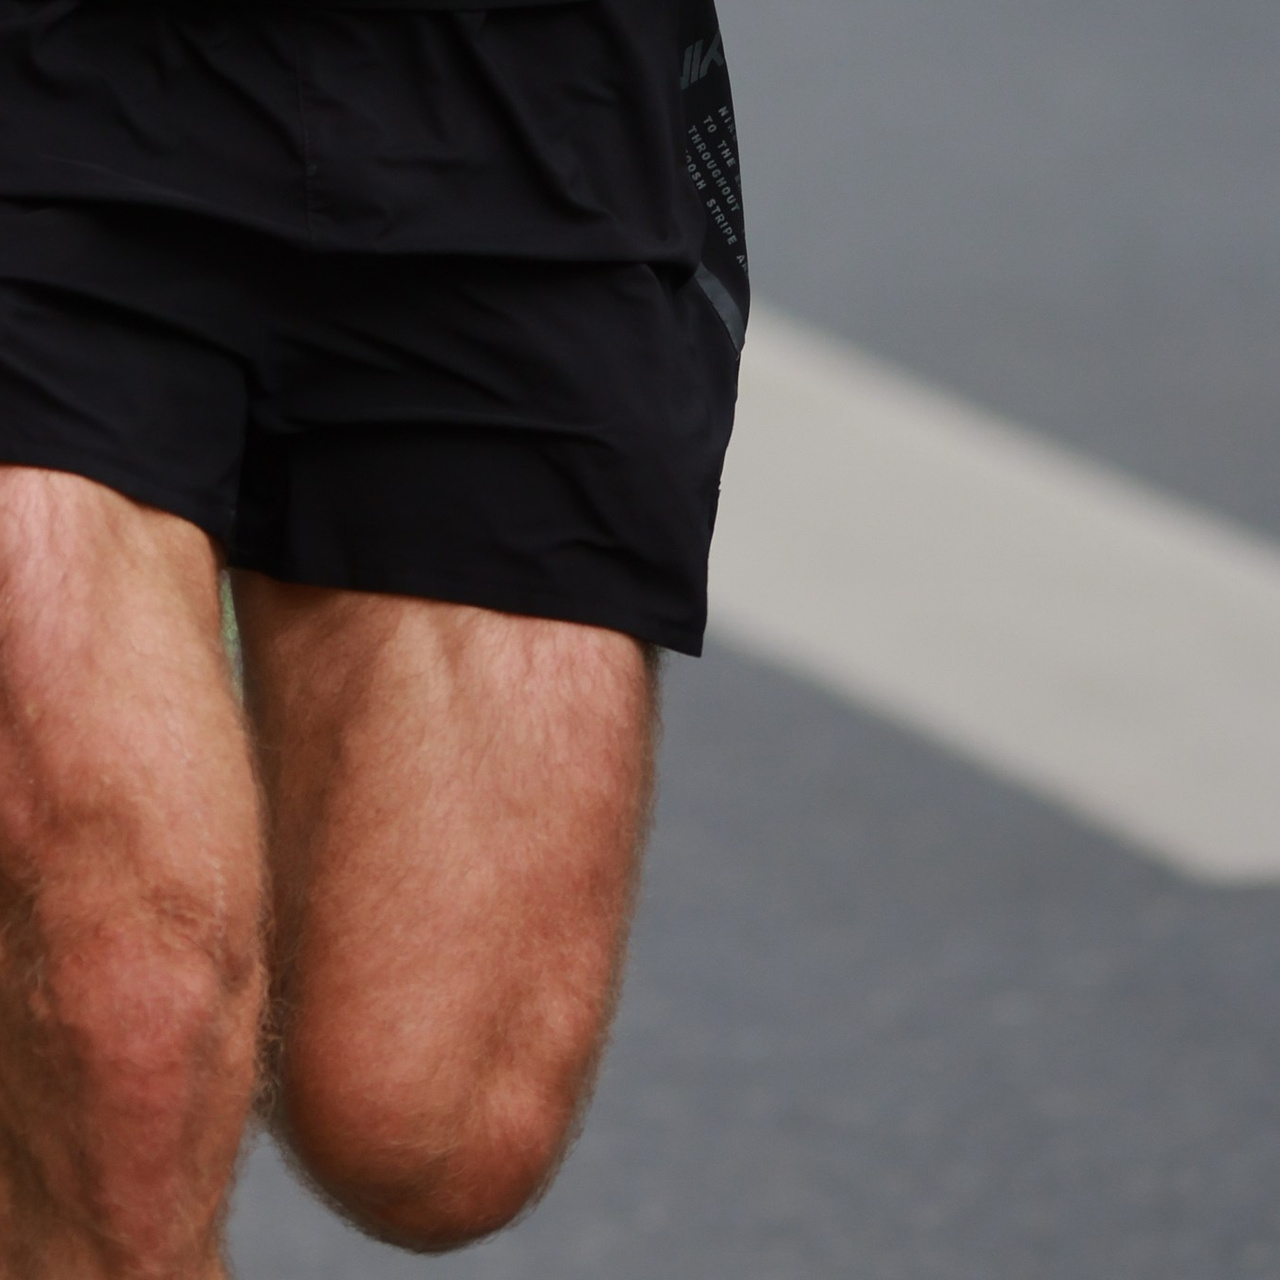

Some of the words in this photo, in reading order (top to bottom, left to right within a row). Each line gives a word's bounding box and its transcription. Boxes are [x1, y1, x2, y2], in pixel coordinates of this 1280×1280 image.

[703, 115, 717, 134] TO
[717, 139, 736, 168] THE
[687, 125, 740, 212] THROUGHOUT
[706, 198, 738, 245] STRIPE
